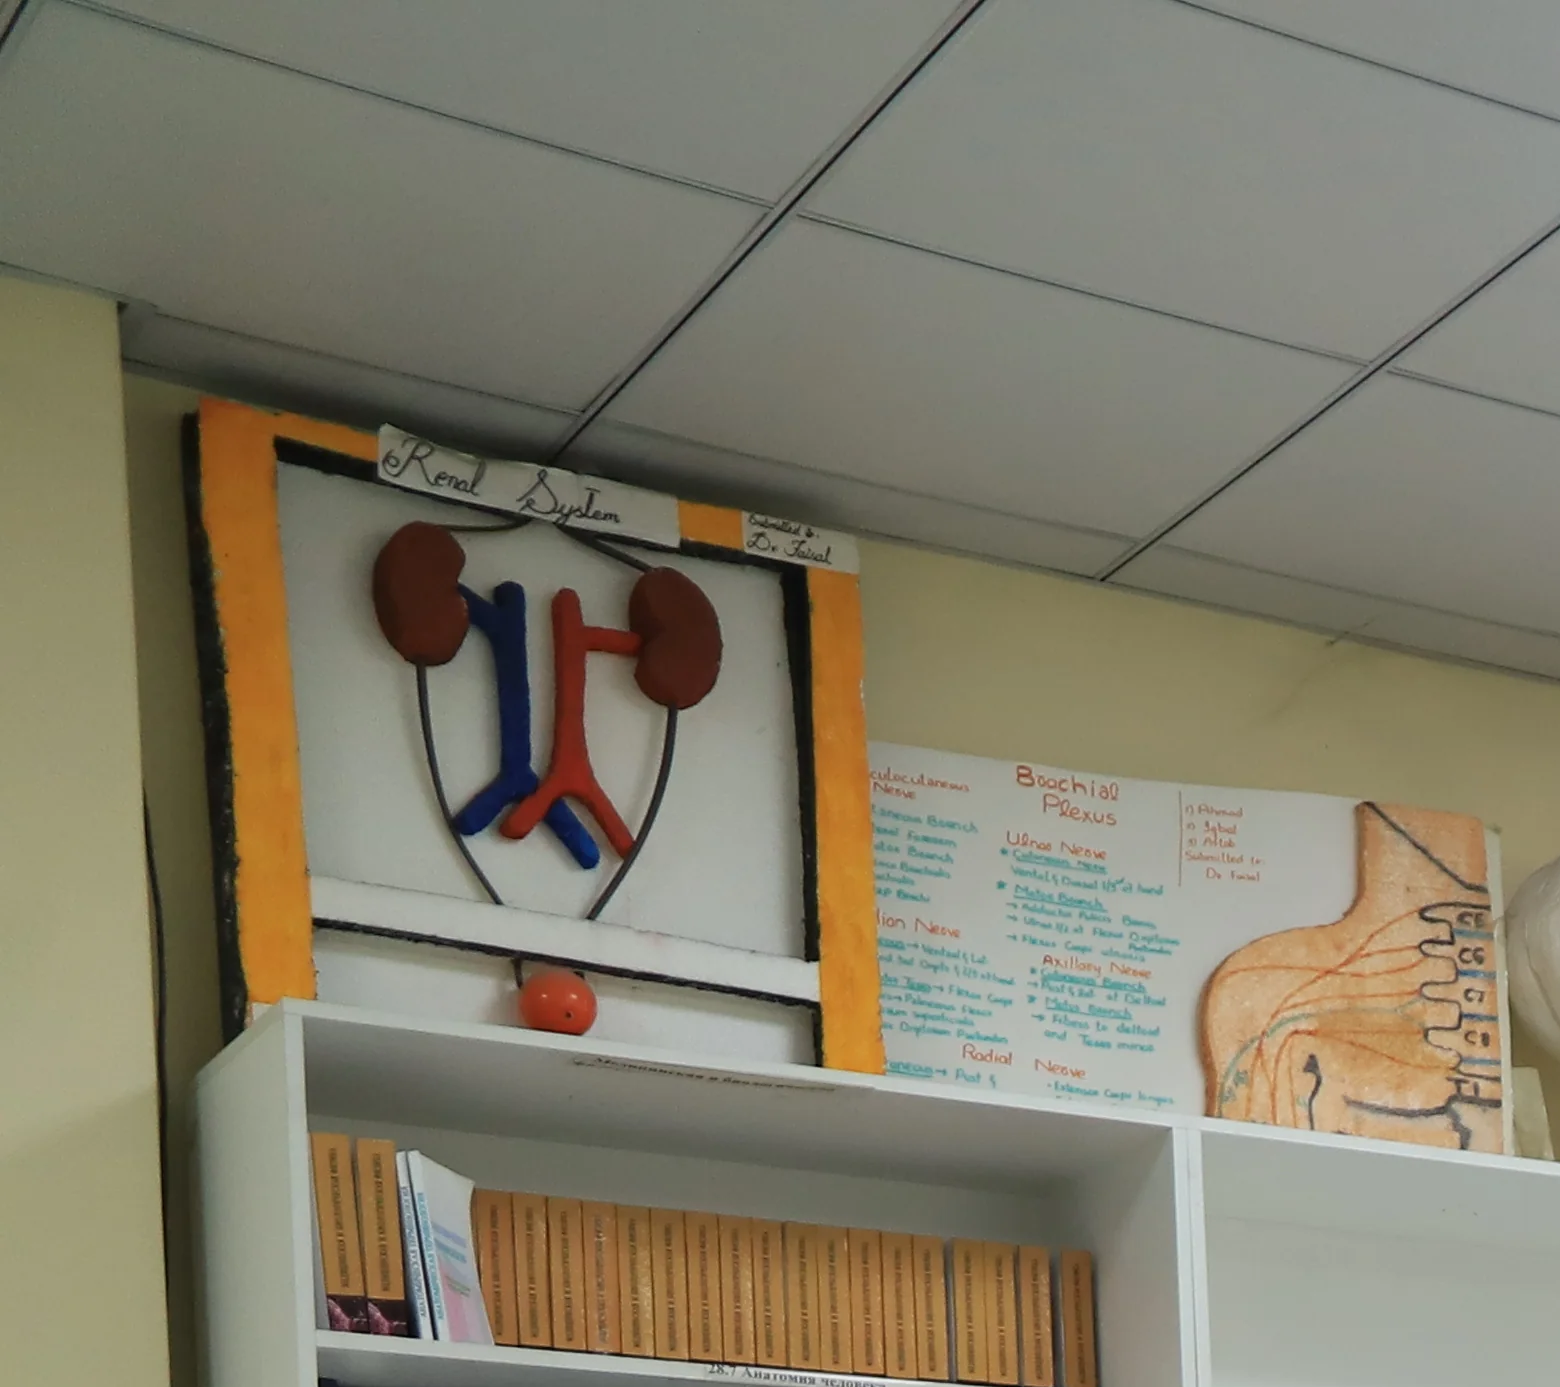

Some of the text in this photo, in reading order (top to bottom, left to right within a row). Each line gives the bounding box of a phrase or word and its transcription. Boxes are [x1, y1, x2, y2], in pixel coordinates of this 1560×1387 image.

[382, 438, 621, 525] Renal System
[1042, 793, 1118, 826] Plexus
[742, 1367, 816, 1385] Анатомия
